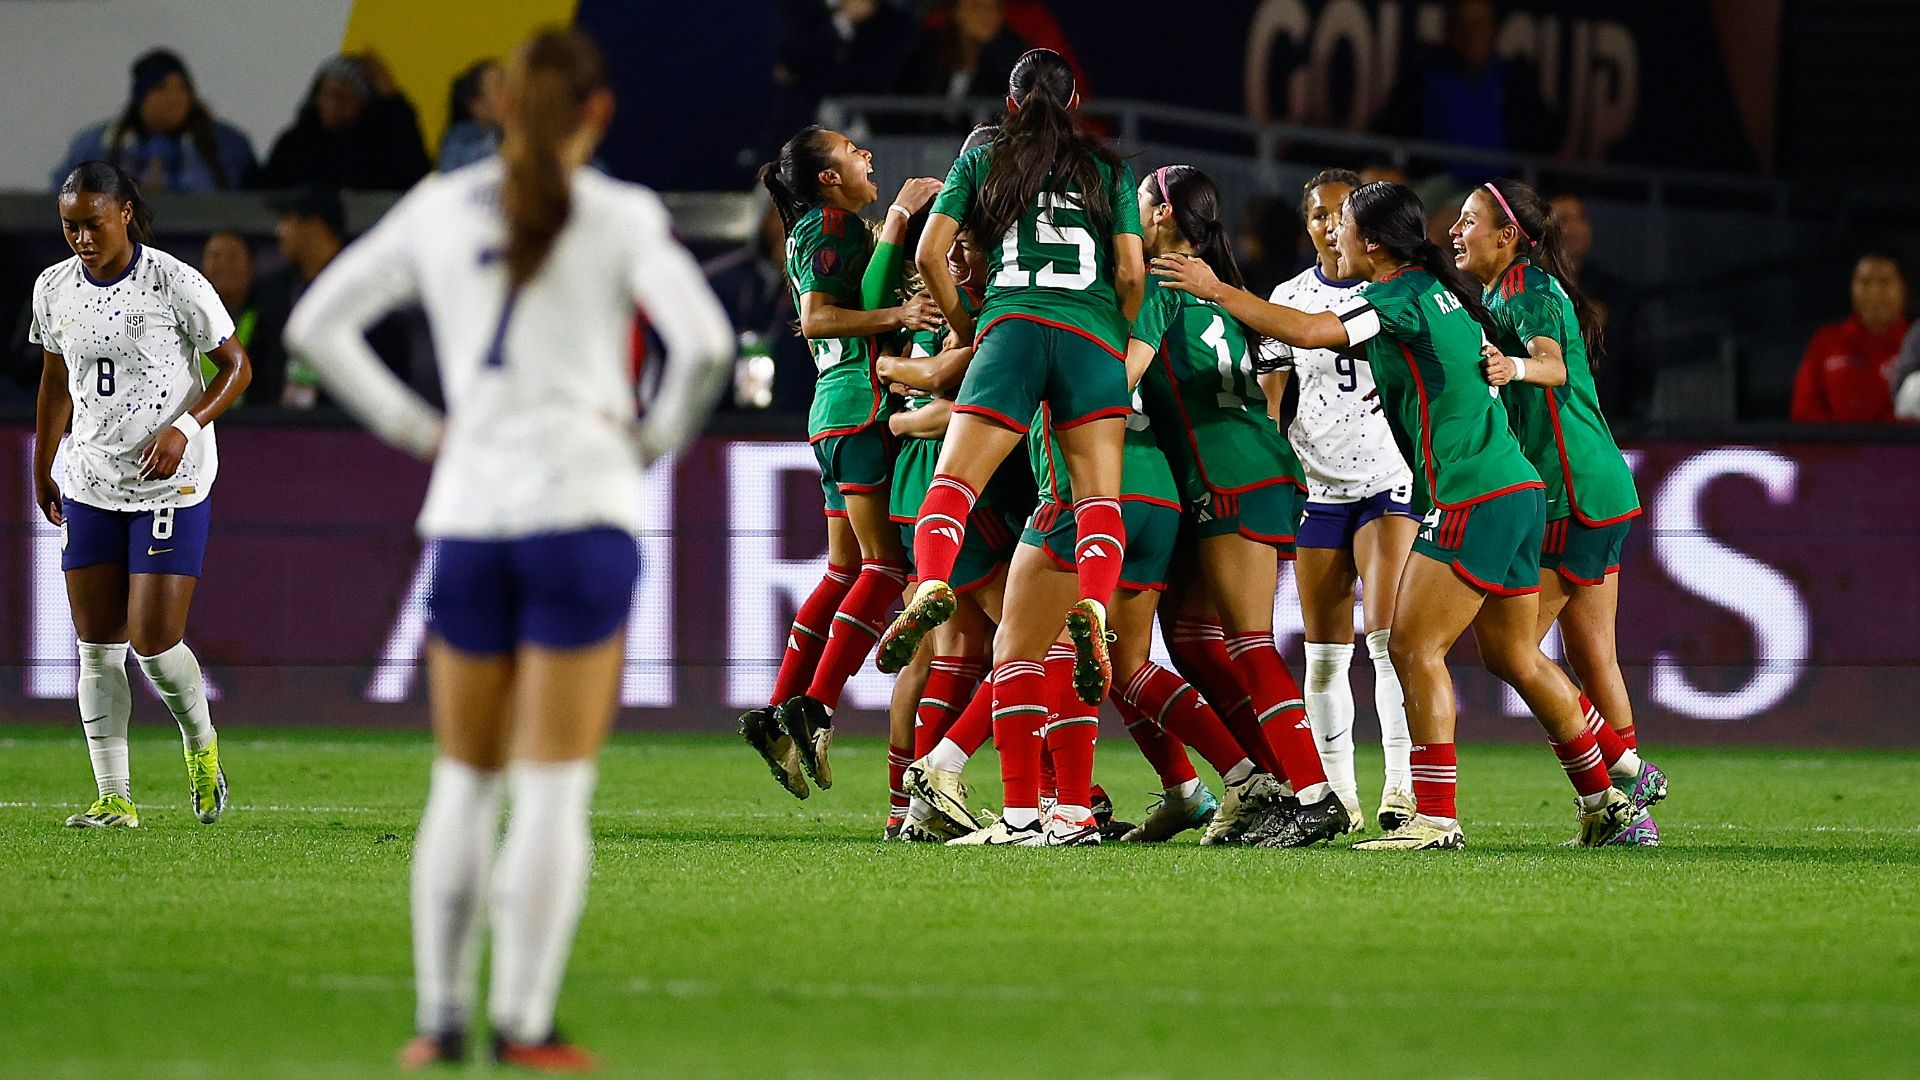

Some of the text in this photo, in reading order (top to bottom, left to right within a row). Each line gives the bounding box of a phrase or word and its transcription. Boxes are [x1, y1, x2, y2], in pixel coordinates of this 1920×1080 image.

[993, 191, 1098, 291] 15
[126, 315, 145, 327] USA
[96, 357, 116, 397] 8
[1335, 354, 1358, 393] 9
[152, 508, 175, 540] 8
